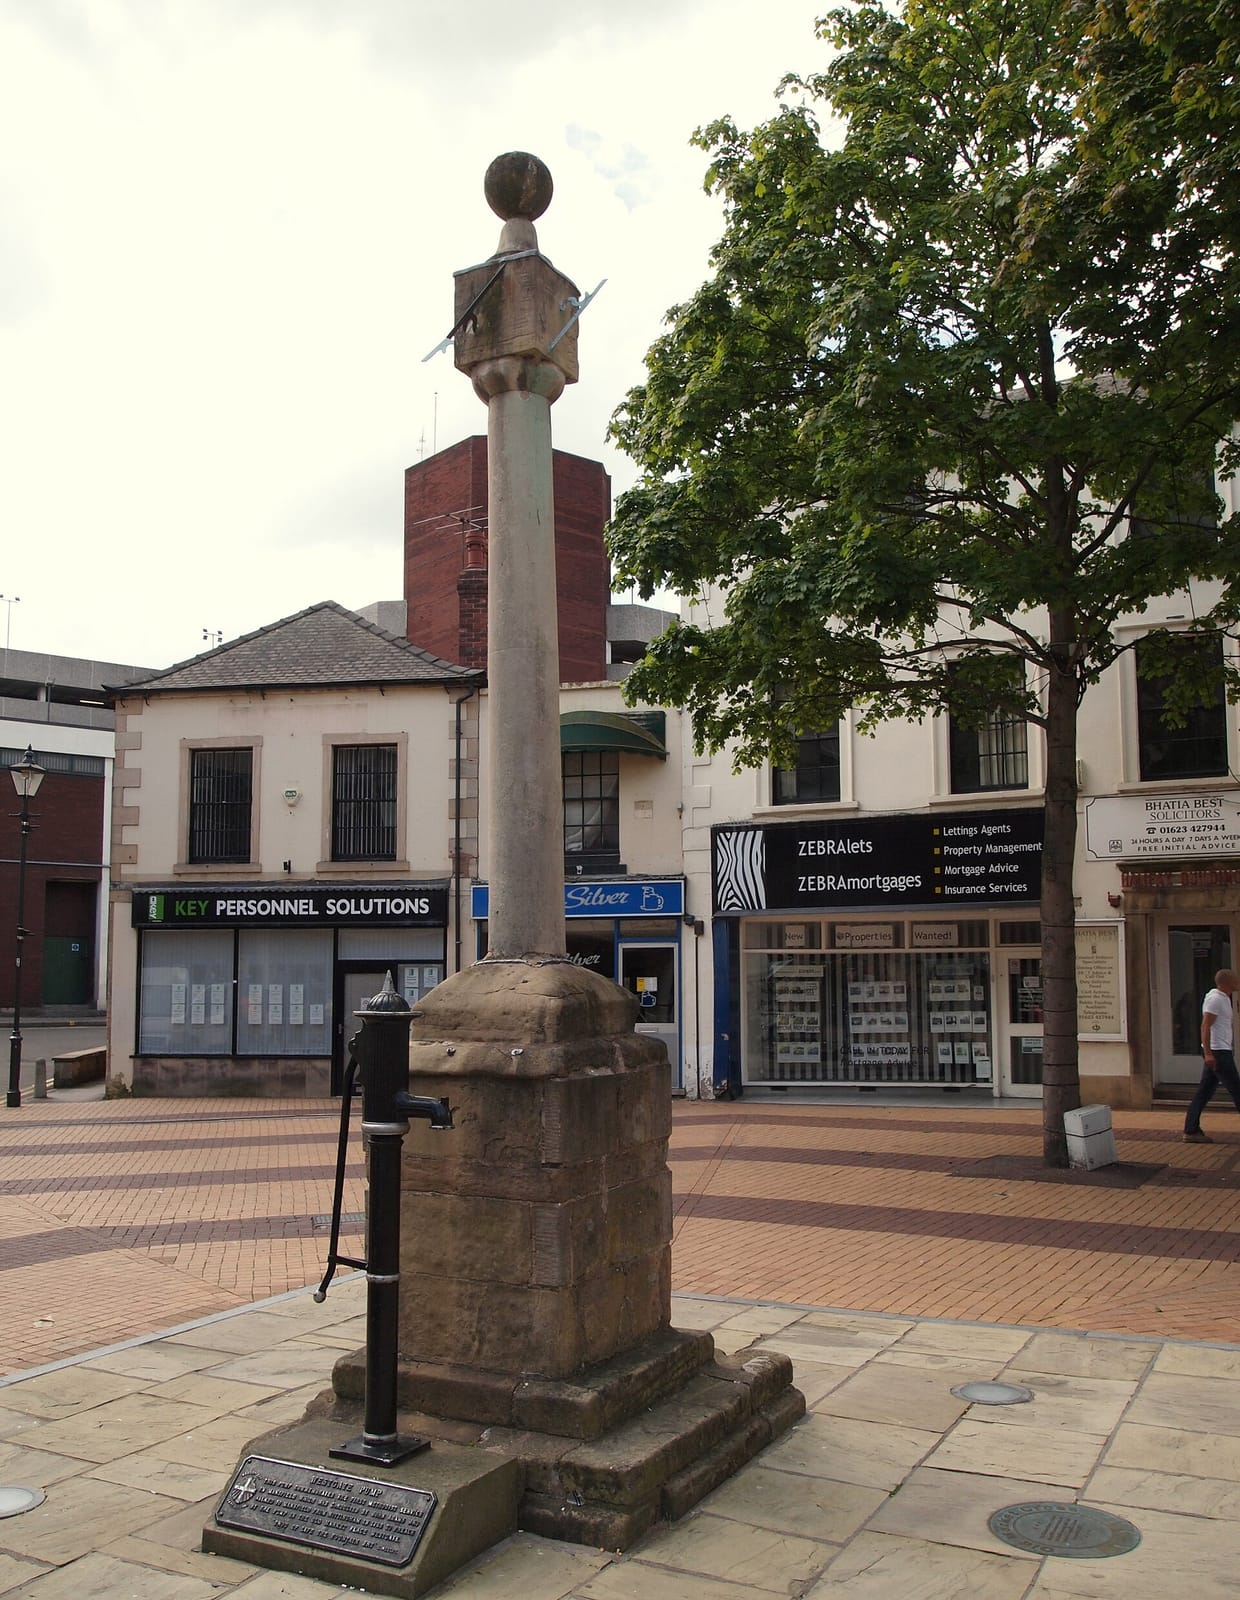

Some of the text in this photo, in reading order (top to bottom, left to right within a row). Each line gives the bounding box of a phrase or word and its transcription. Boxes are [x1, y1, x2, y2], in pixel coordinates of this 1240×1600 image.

[1145, 799, 1224, 811] BHATIA BEST
[1150, 809, 1221, 820] SOLICITORS
[943, 824, 1011, 837] Lettings Agents
[1190, 824, 1226, 832] 427944
[798, 839, 873, 856] ZEBRAlets
[943, 842, 1043, 857] Property Management
[944, 863, 1020, 877] Mortgage Advice
[798, 874, 922, 892] ZEBRAmortgages
[944, 882, 1028, 895] Insurance Services
[565, 886, 630, 908] Silver
[175, 898, 430, 916] KEY PERSONNEL SOLUTIONS
[785, 930, 952, 943] New Properties Wanted!
[880, 1046, 908, 1055] TODAY
[311, 1476, 383, 1498] WESTGATE PUMP
